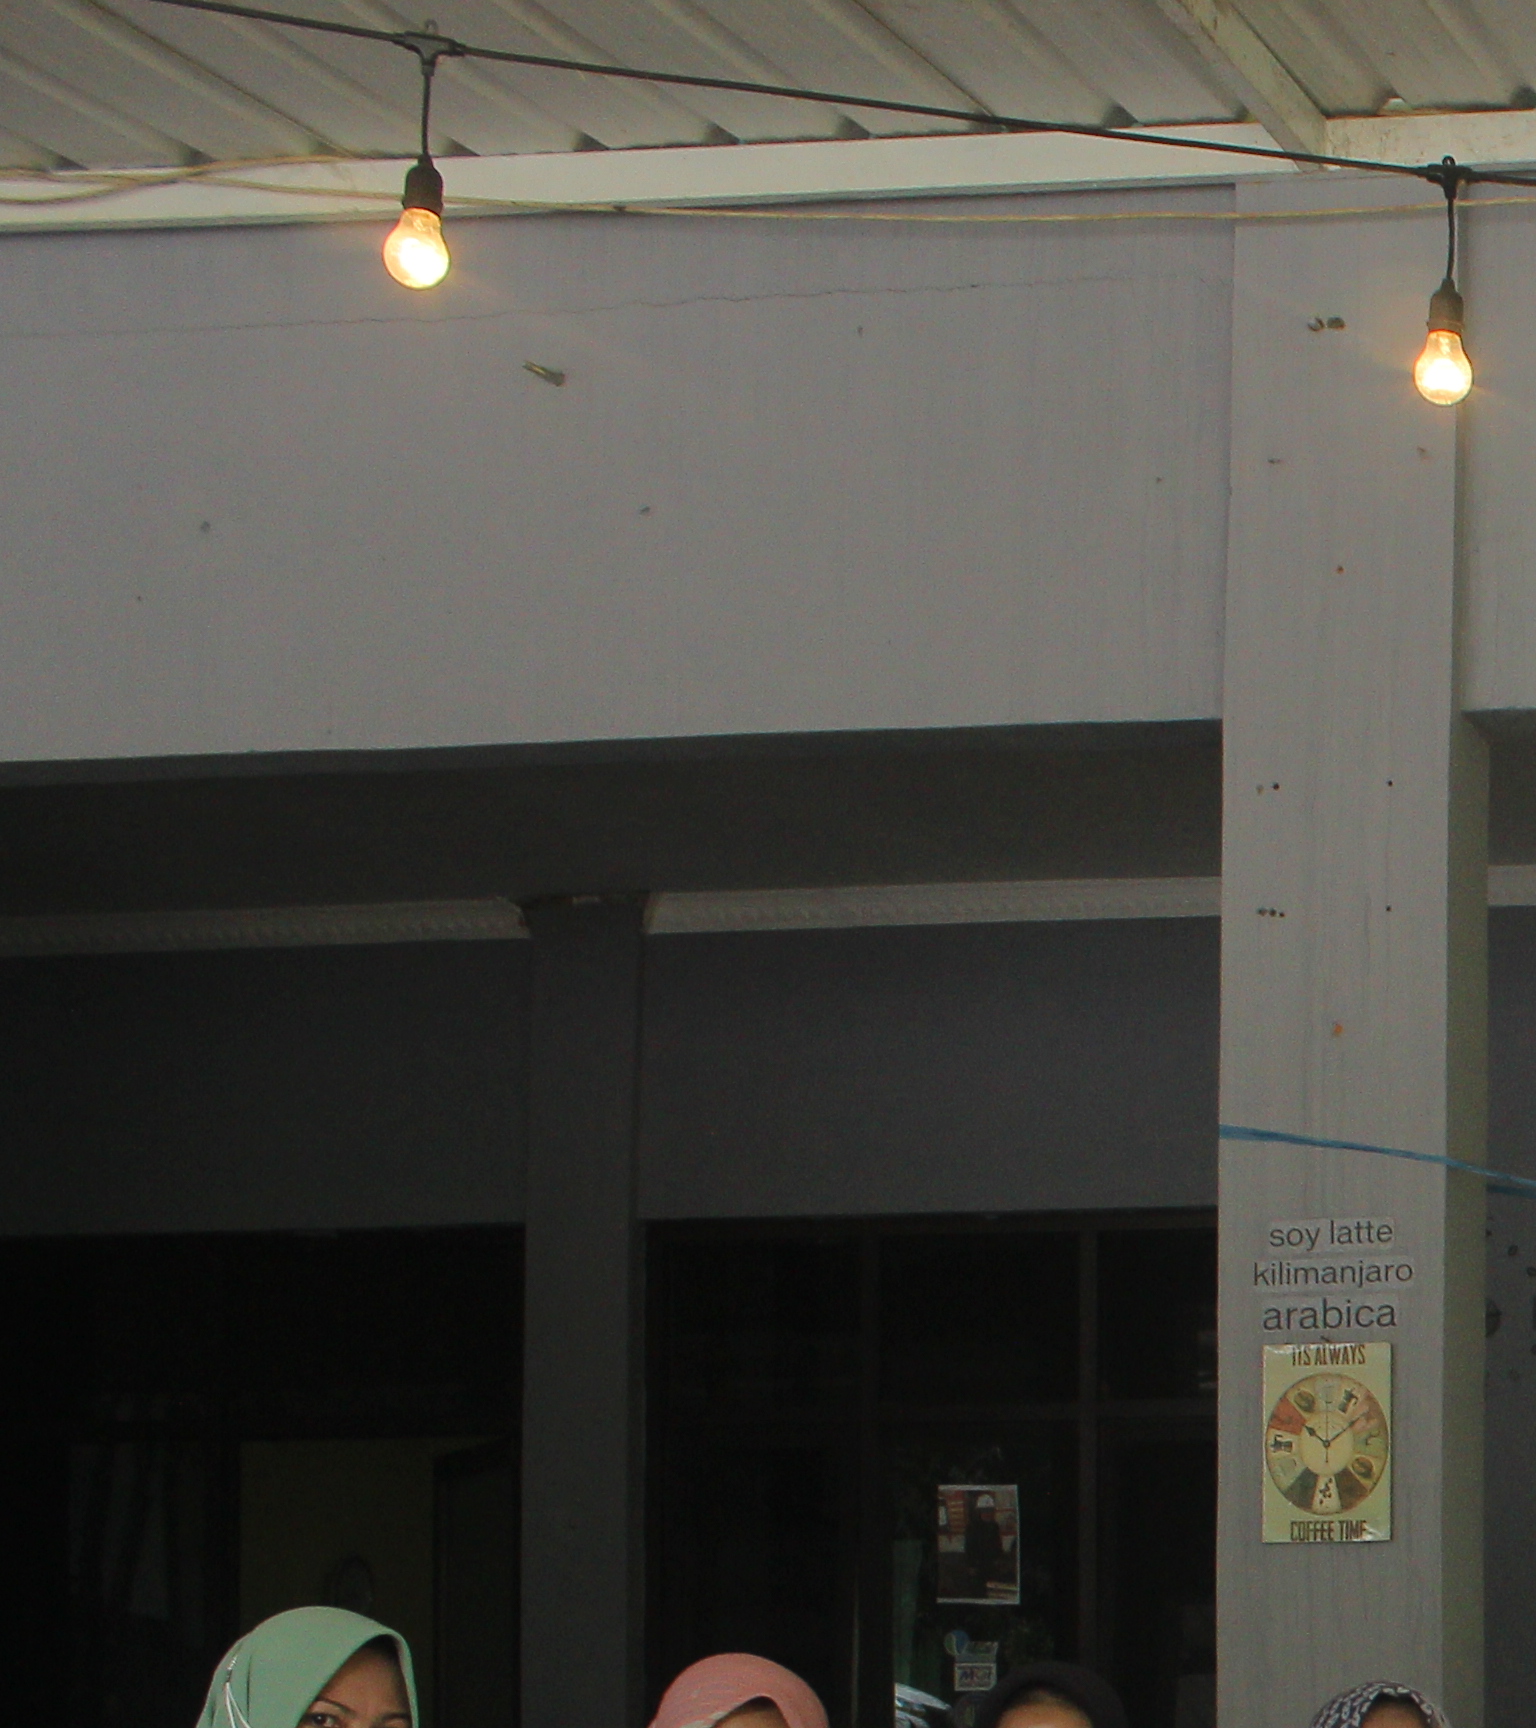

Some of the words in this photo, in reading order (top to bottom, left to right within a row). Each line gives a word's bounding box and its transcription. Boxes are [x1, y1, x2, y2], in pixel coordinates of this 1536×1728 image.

[1269, 1227, 1320, 1250] soy
[1330, 1220, 1393, 1244] latte
[1254, 1261, 1413, 1291] kilimanjaro
[1263, 1299, 1397, 1331] arabica
[1290, 1520, 1334, 1542] COFFEE
